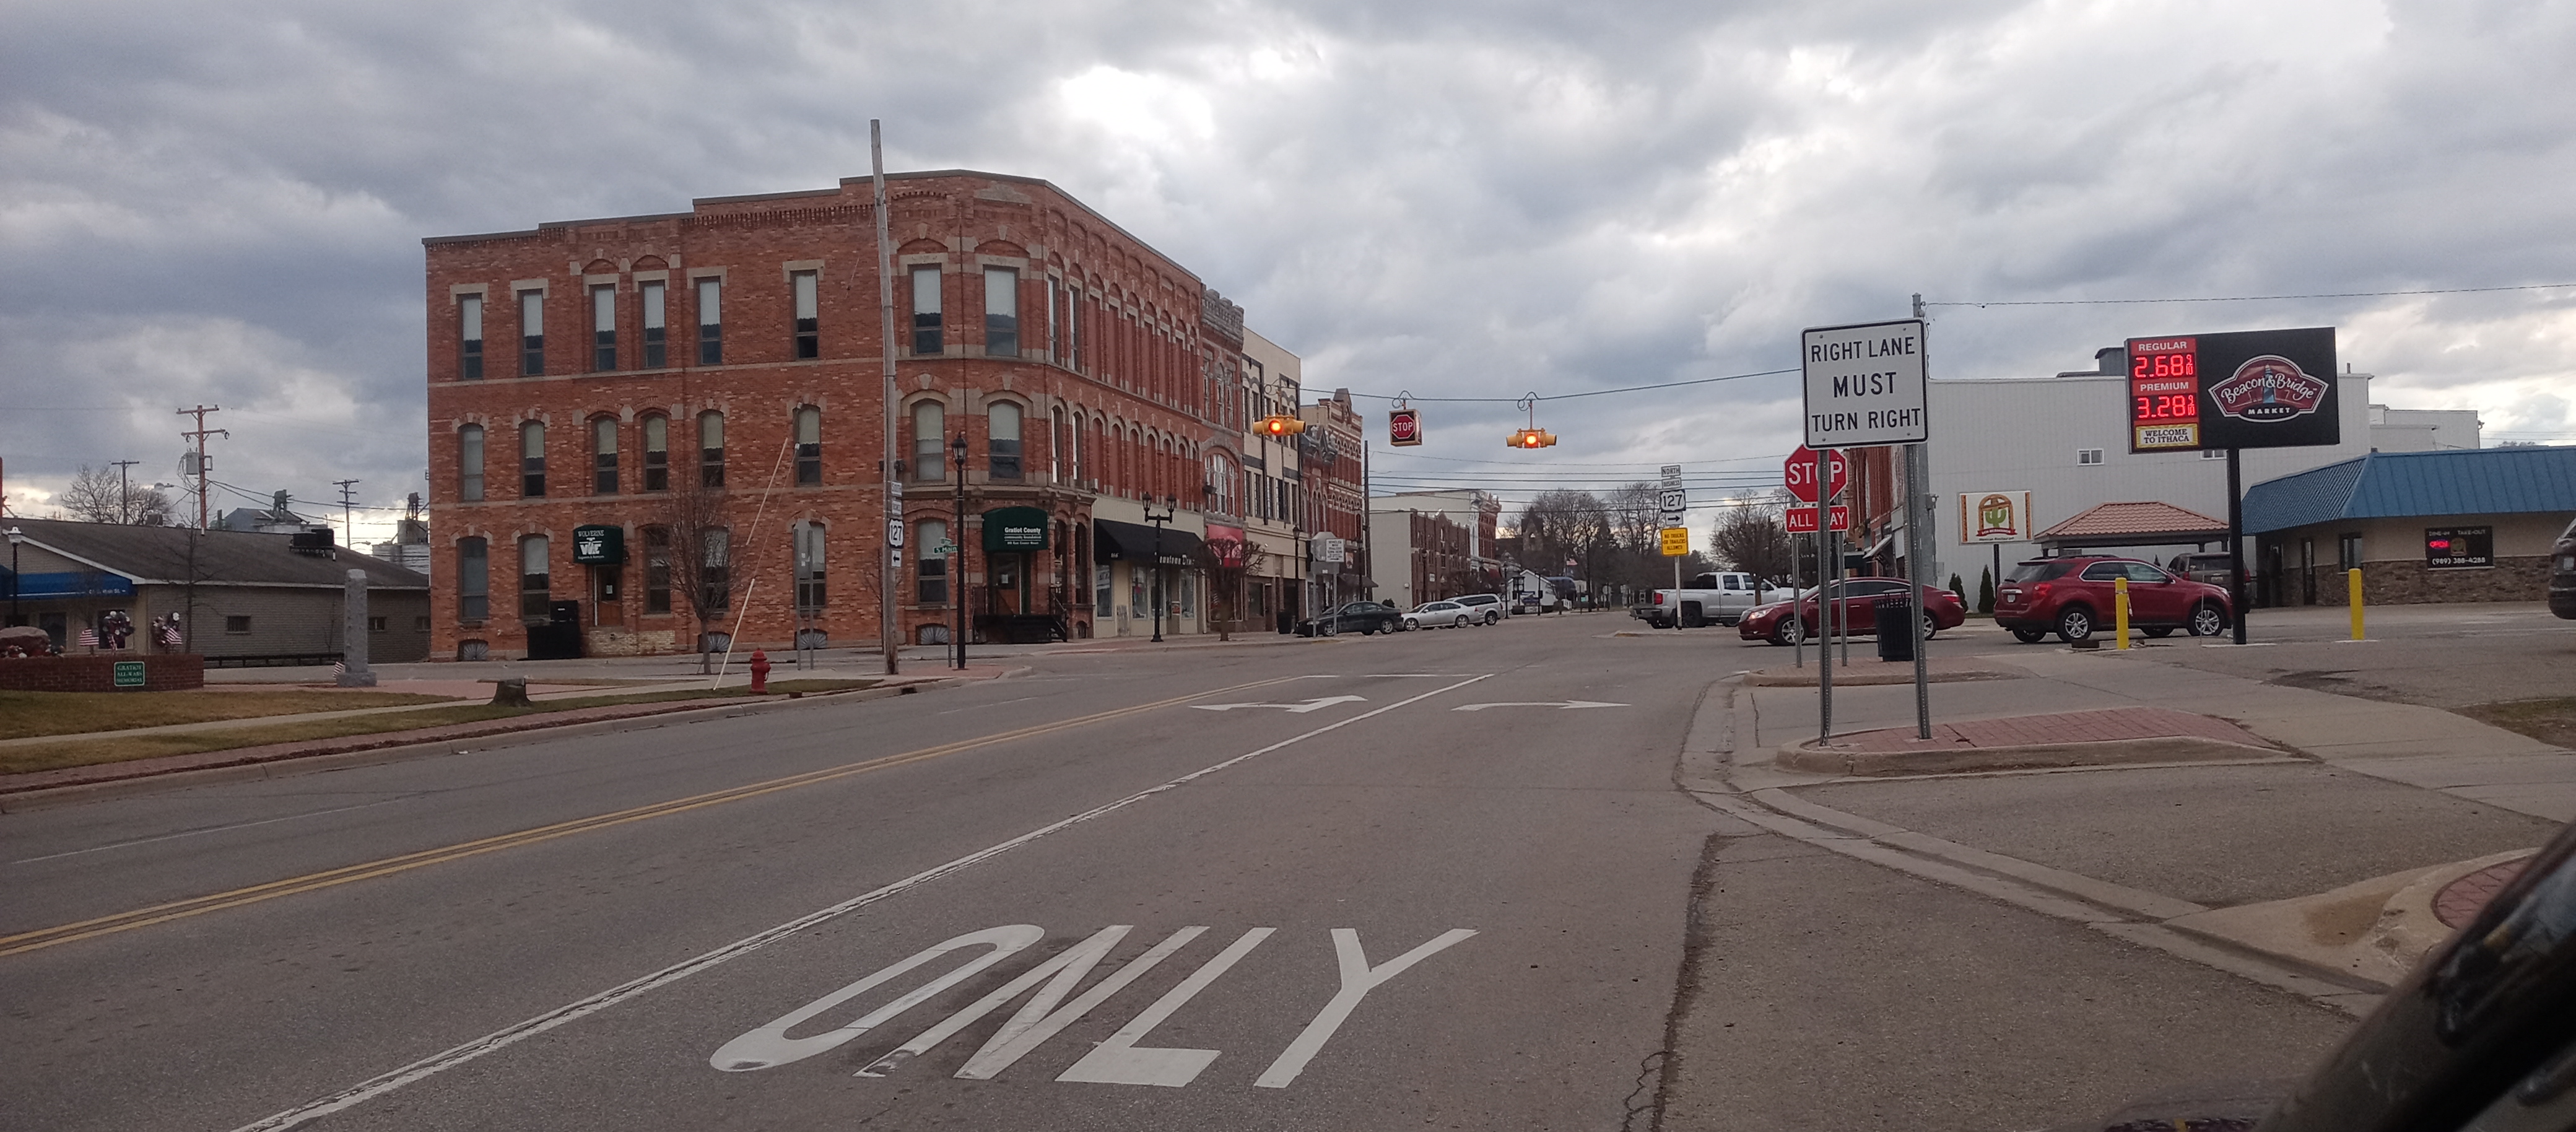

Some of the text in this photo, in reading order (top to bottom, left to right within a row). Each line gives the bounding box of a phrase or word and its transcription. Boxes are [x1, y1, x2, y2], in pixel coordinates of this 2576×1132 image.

[1811, 337, 1915, 362] RIGHT LANE
[2139, 341, 2187, 351] REGULAR
[2134, 355, 2184, 378] 2.68
[1834, 372, 1897, 398] MUST
[2140, 382, 2189, 391] PREMIUM
[2221, 373, 2315, 404] Beacon & Bridge
[2138, 395, 2185, 419] 3.28
[1393, 422, 1413, 432] STOP
[1812, 408, 1920, 432] TURN RIGHT
[2145, 429, 2188, 437] WELCOME
[1788, 461, 1843, 484] STP
[1663, 494, 1682, 507] 127
[1789, 512, 1845, 527] ALL AY
[890, 525, 902, 541] 127
[710, 925, 1479, 1088] ONLY
